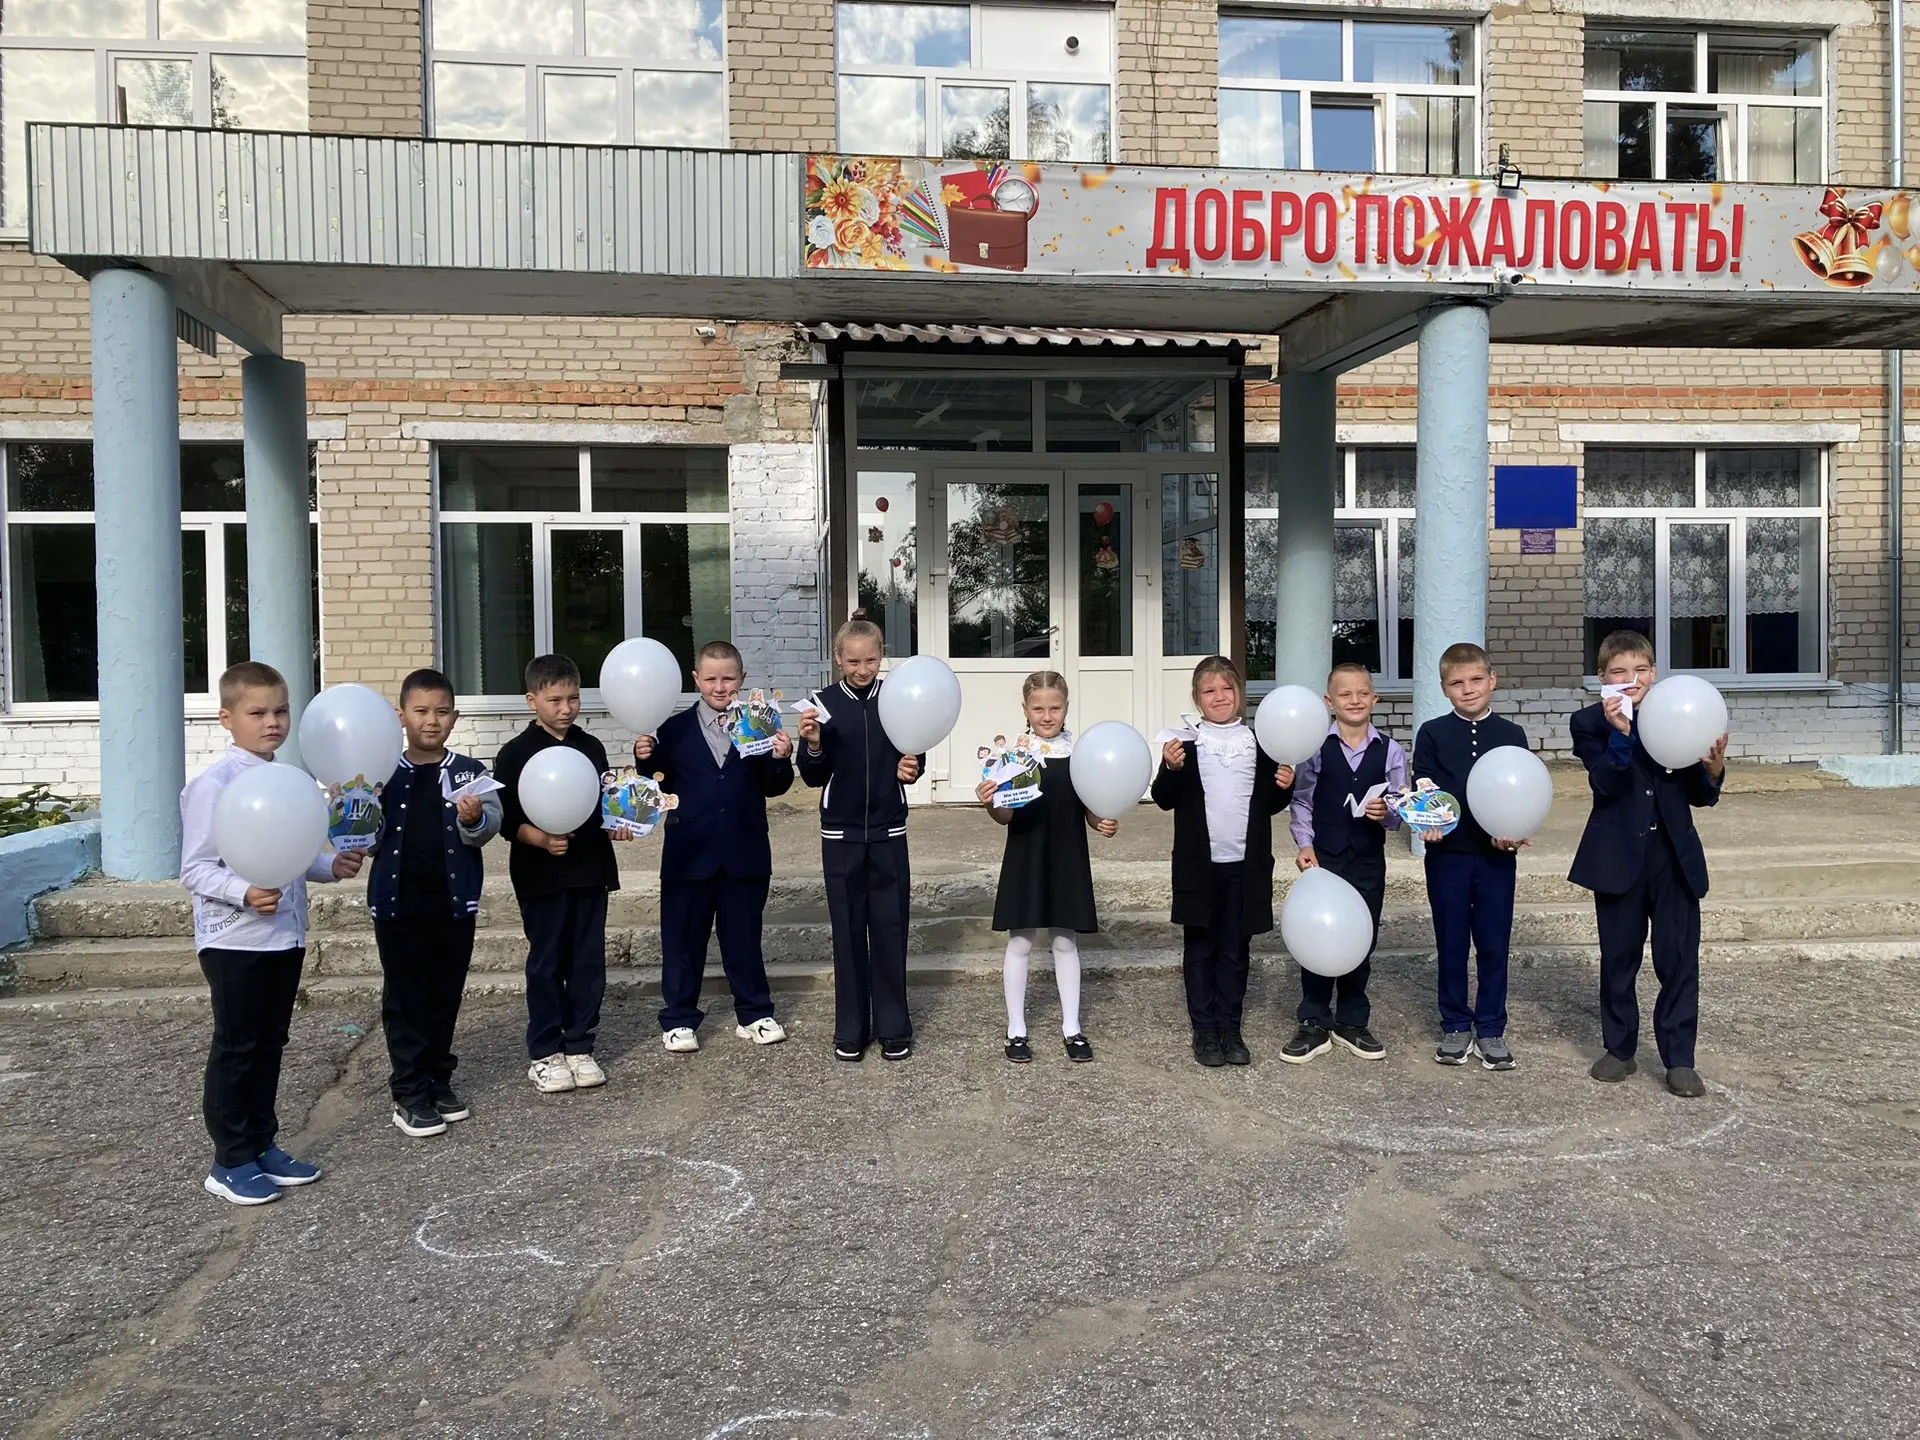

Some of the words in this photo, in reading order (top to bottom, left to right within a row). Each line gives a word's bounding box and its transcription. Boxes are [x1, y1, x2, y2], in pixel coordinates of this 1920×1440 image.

[1146, 187, 1338, 269] ДОБРО
[1355, 193, 1744, 273] ПОЖАЛОВАТЬ!
[209, 906, 245, 934] DIVISION
